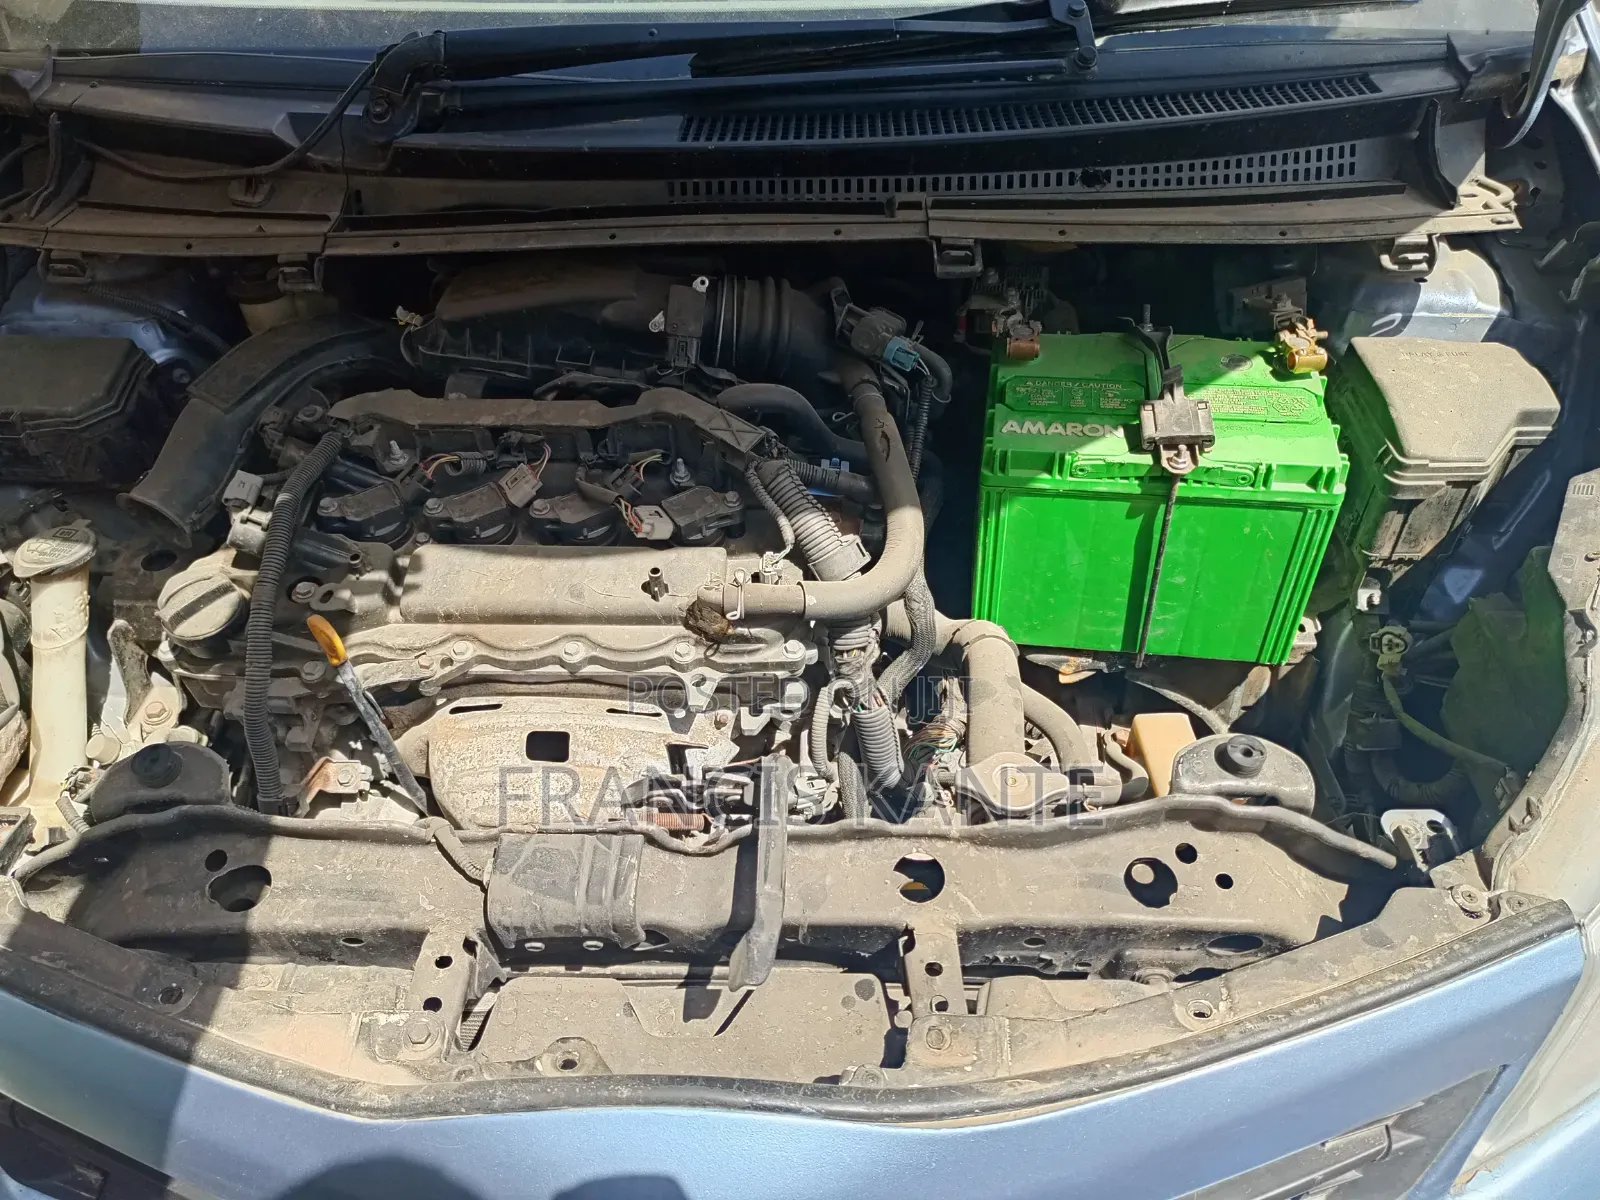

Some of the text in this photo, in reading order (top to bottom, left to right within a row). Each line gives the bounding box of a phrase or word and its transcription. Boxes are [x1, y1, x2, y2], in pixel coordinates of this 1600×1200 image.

[1035, 380, 1072, 388] DANGER
[1081, 382, 1123, 390] CAUTION
[1001, 419, 1124, 439] AMARON
